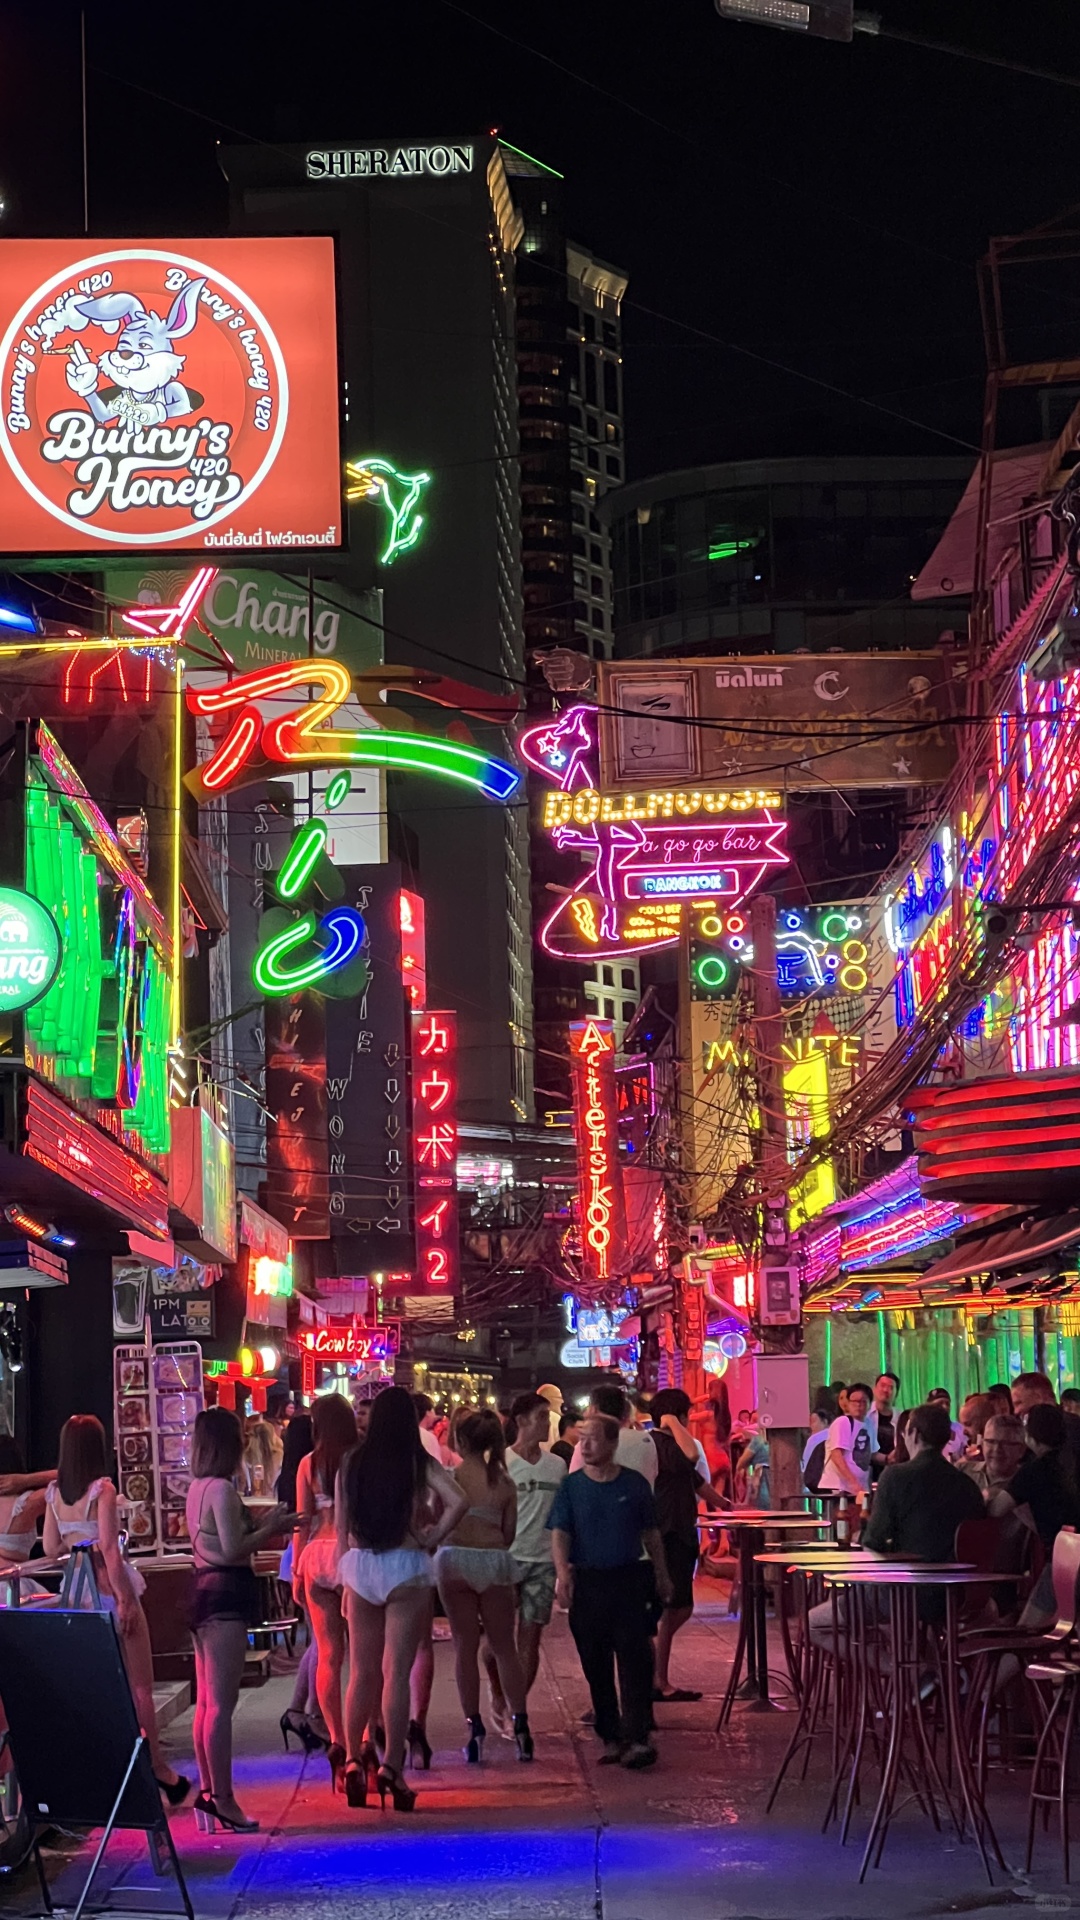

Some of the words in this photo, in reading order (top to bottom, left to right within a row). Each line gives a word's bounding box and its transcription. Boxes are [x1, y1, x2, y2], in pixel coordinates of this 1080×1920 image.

[307, 145, 473, 178] SHERATON
[7, 340, 36, 433] Bunny's
[24, 288, 75, 341] hne
[78, 271, 112, 294] 420
[164, 268, 246, 329] Bnny's
[238, 329, 270, 391] honey
[254, 396, 274, 430] 420
[43, 412, 230, 468] Bunny's
[69, 456, 241, 518] Honey
[190, 459, 228, 476] 420
[203, 575, 341, 655] Chang
[544, 788, 782, 828] DOLLHOUSE
[664, 838, 690, 864] go
[693, 838, 719, 864] go
[722, 826, 762, 851] bar
[643, 874, 722, 892] BANGKOK
[153, 1299, 181, 1310] 1PM
[315, 1329, 373, 1359] Cowboy
